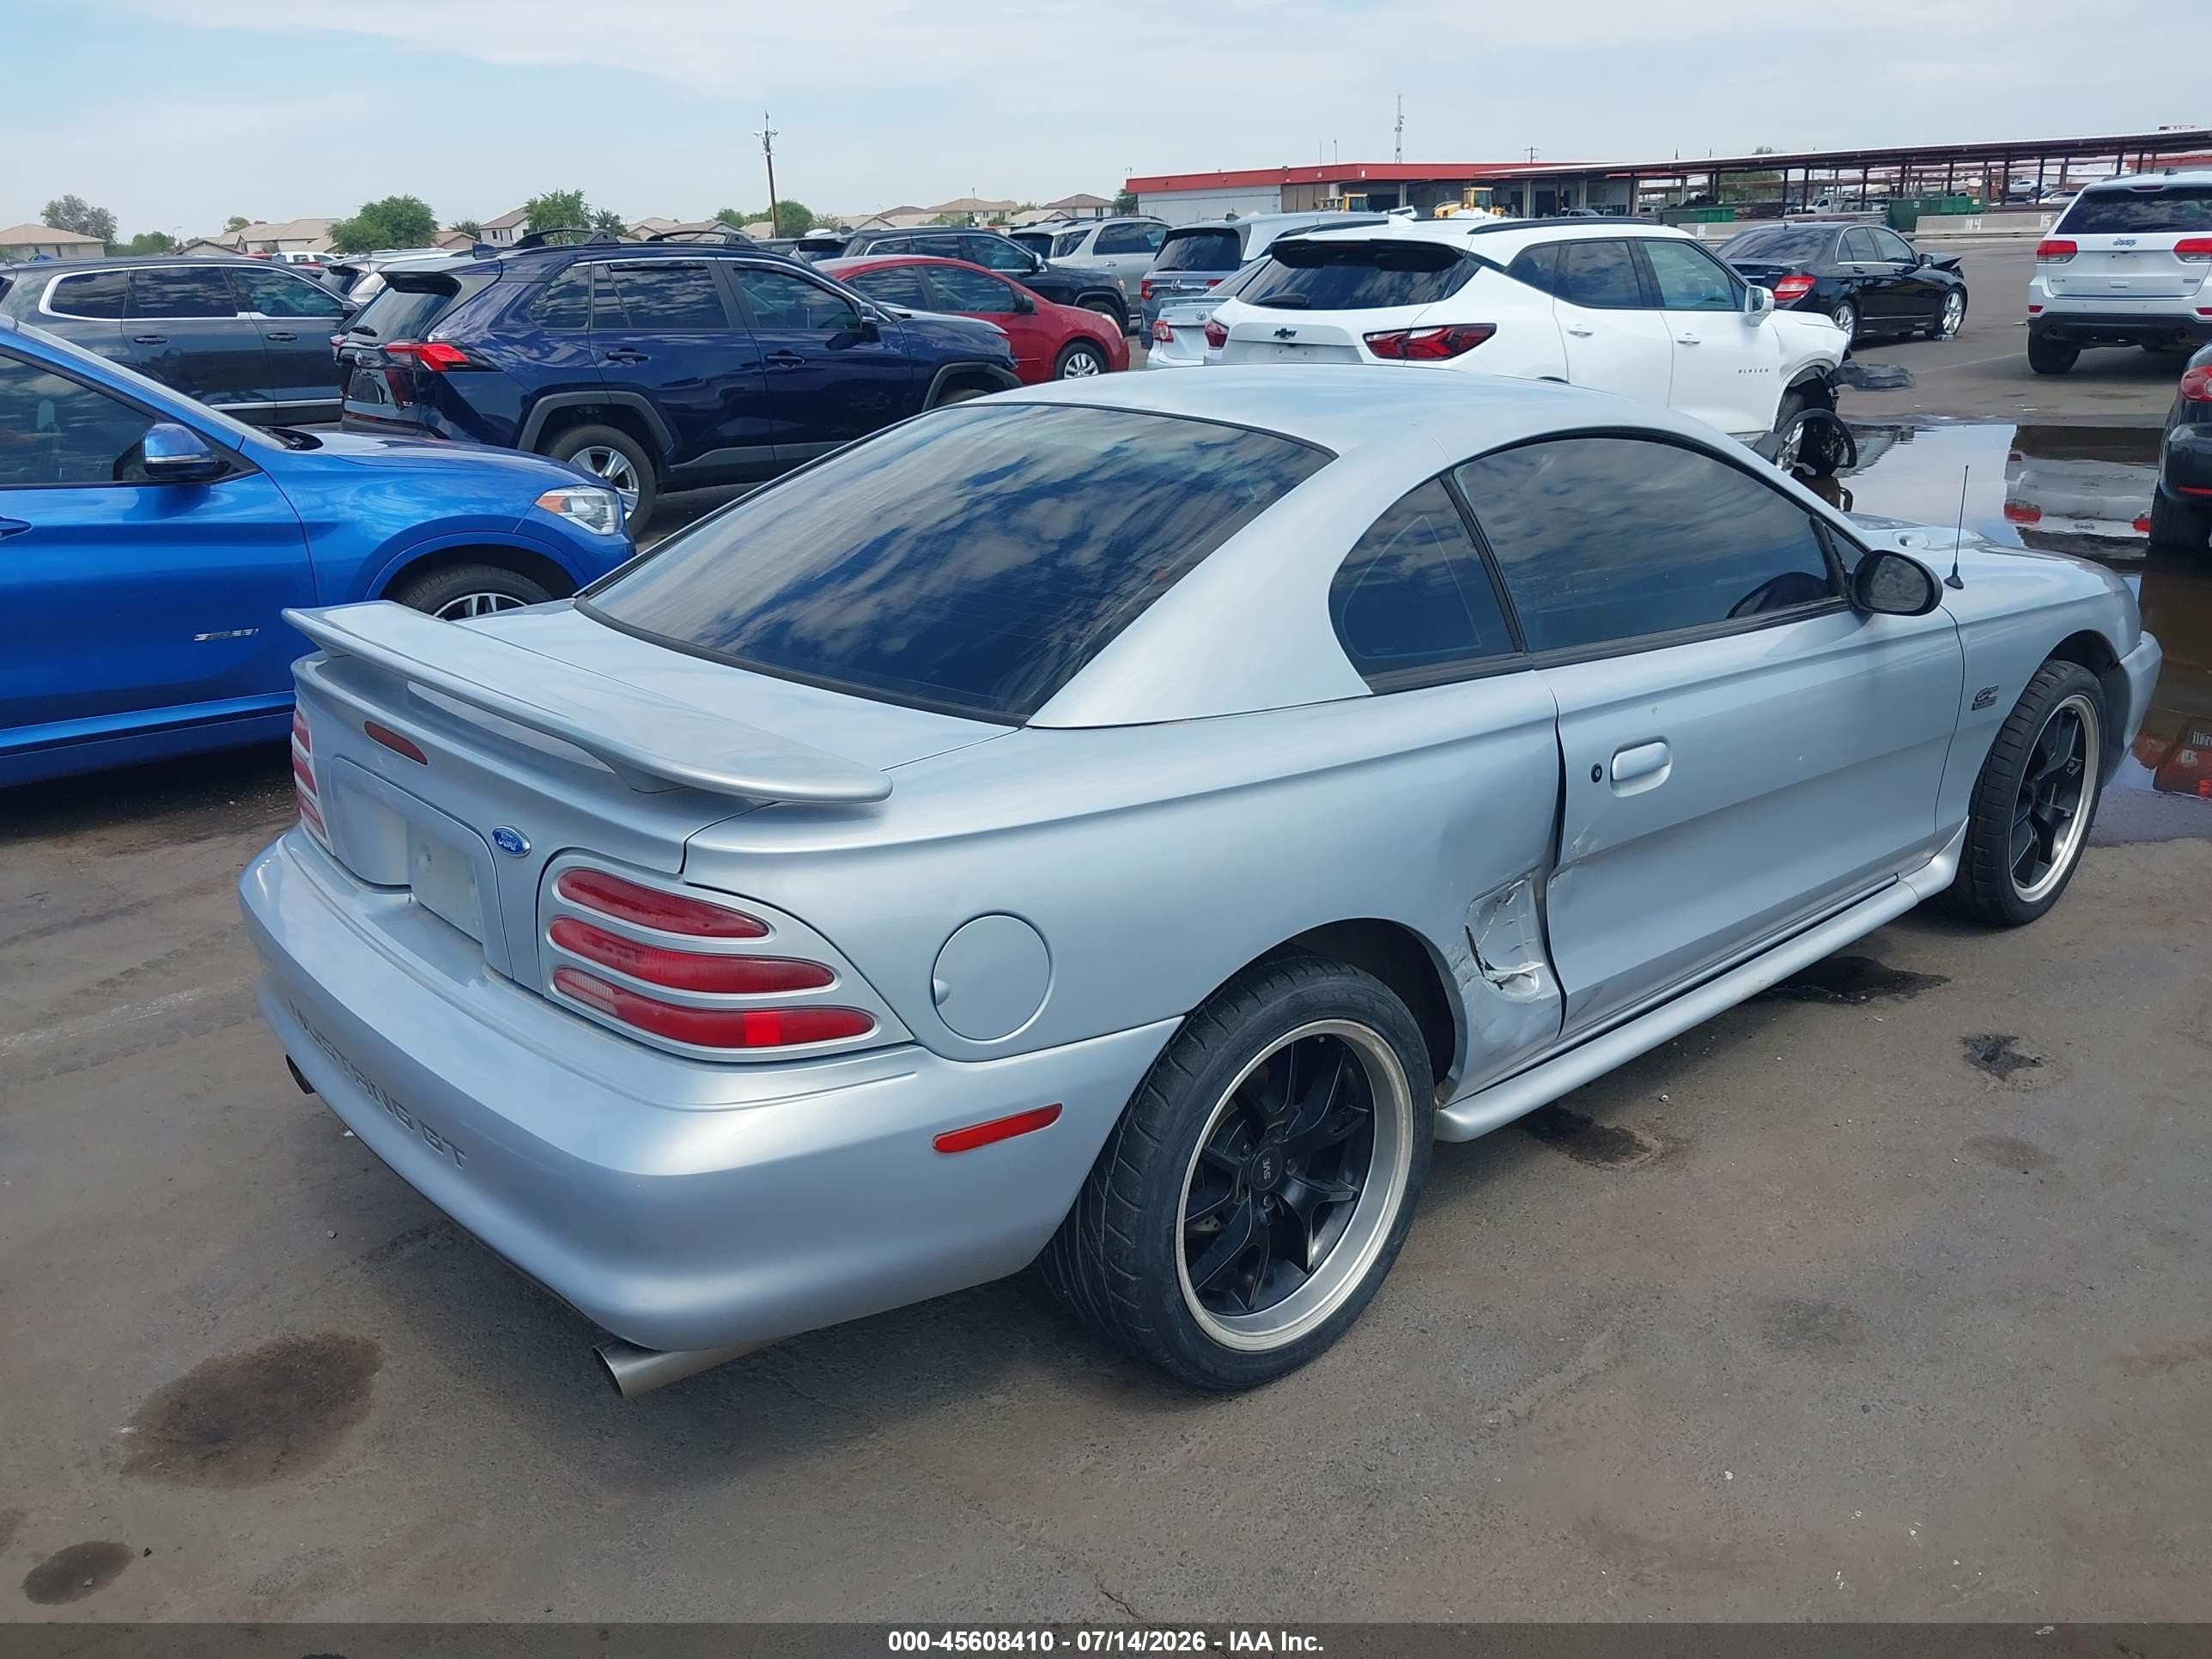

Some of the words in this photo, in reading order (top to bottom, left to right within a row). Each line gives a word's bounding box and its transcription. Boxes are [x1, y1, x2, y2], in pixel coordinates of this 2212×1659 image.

[2113, 238, 2137, 246] Jeep
[498, 832, 519, 851] Ford
[417, 1119, 467, 1170] GT
[1262, 1157, 1271, 1180] SVE
